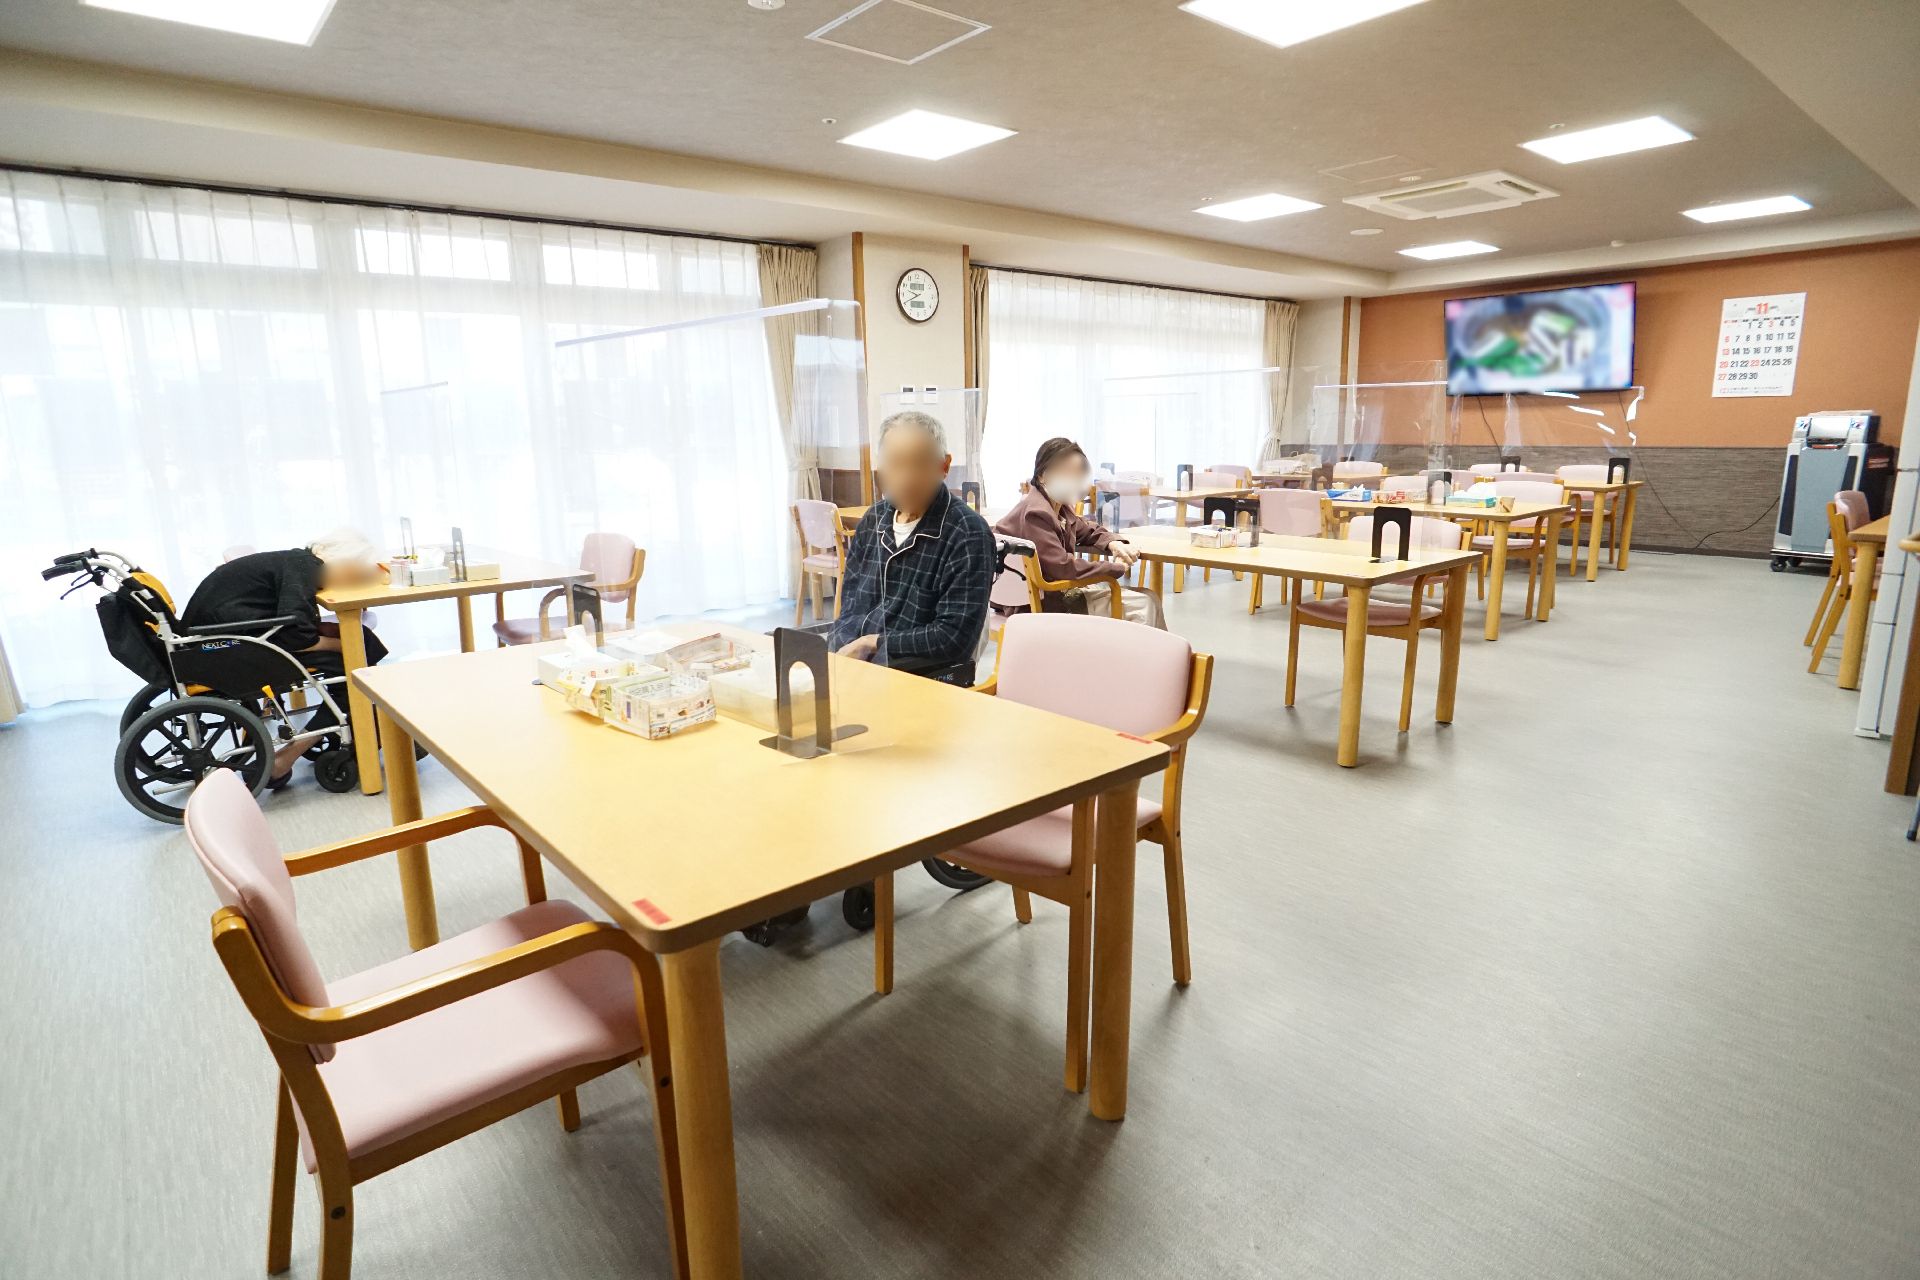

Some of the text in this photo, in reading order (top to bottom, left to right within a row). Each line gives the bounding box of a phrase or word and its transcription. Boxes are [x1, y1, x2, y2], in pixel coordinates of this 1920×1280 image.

[1755, 302, 1769, 314] 11
[1757, 321, 1763, 329] 2
[1768, 320, 1774, 328] 3
[1779, 319, 1785, 327] 4
[1756, 334, 1761, 342] 9
[1765, 333, 1774, 341] 10
[1777, 333, 1784, 341] 11
[1788, 332, 1796, 340] 12
[1743, 347, 1750, 355] 15
[1764, 346, 1772, 354] 17
[1785, 345, 1793, 353] 19
[1719, 358, 1792, 369] 20 21 22 23 24 25 26
[1718, 373, 1727, 381] 27
[1739, 372, 1748, 380] 29
[1749, 372, 1758, 380] 30
